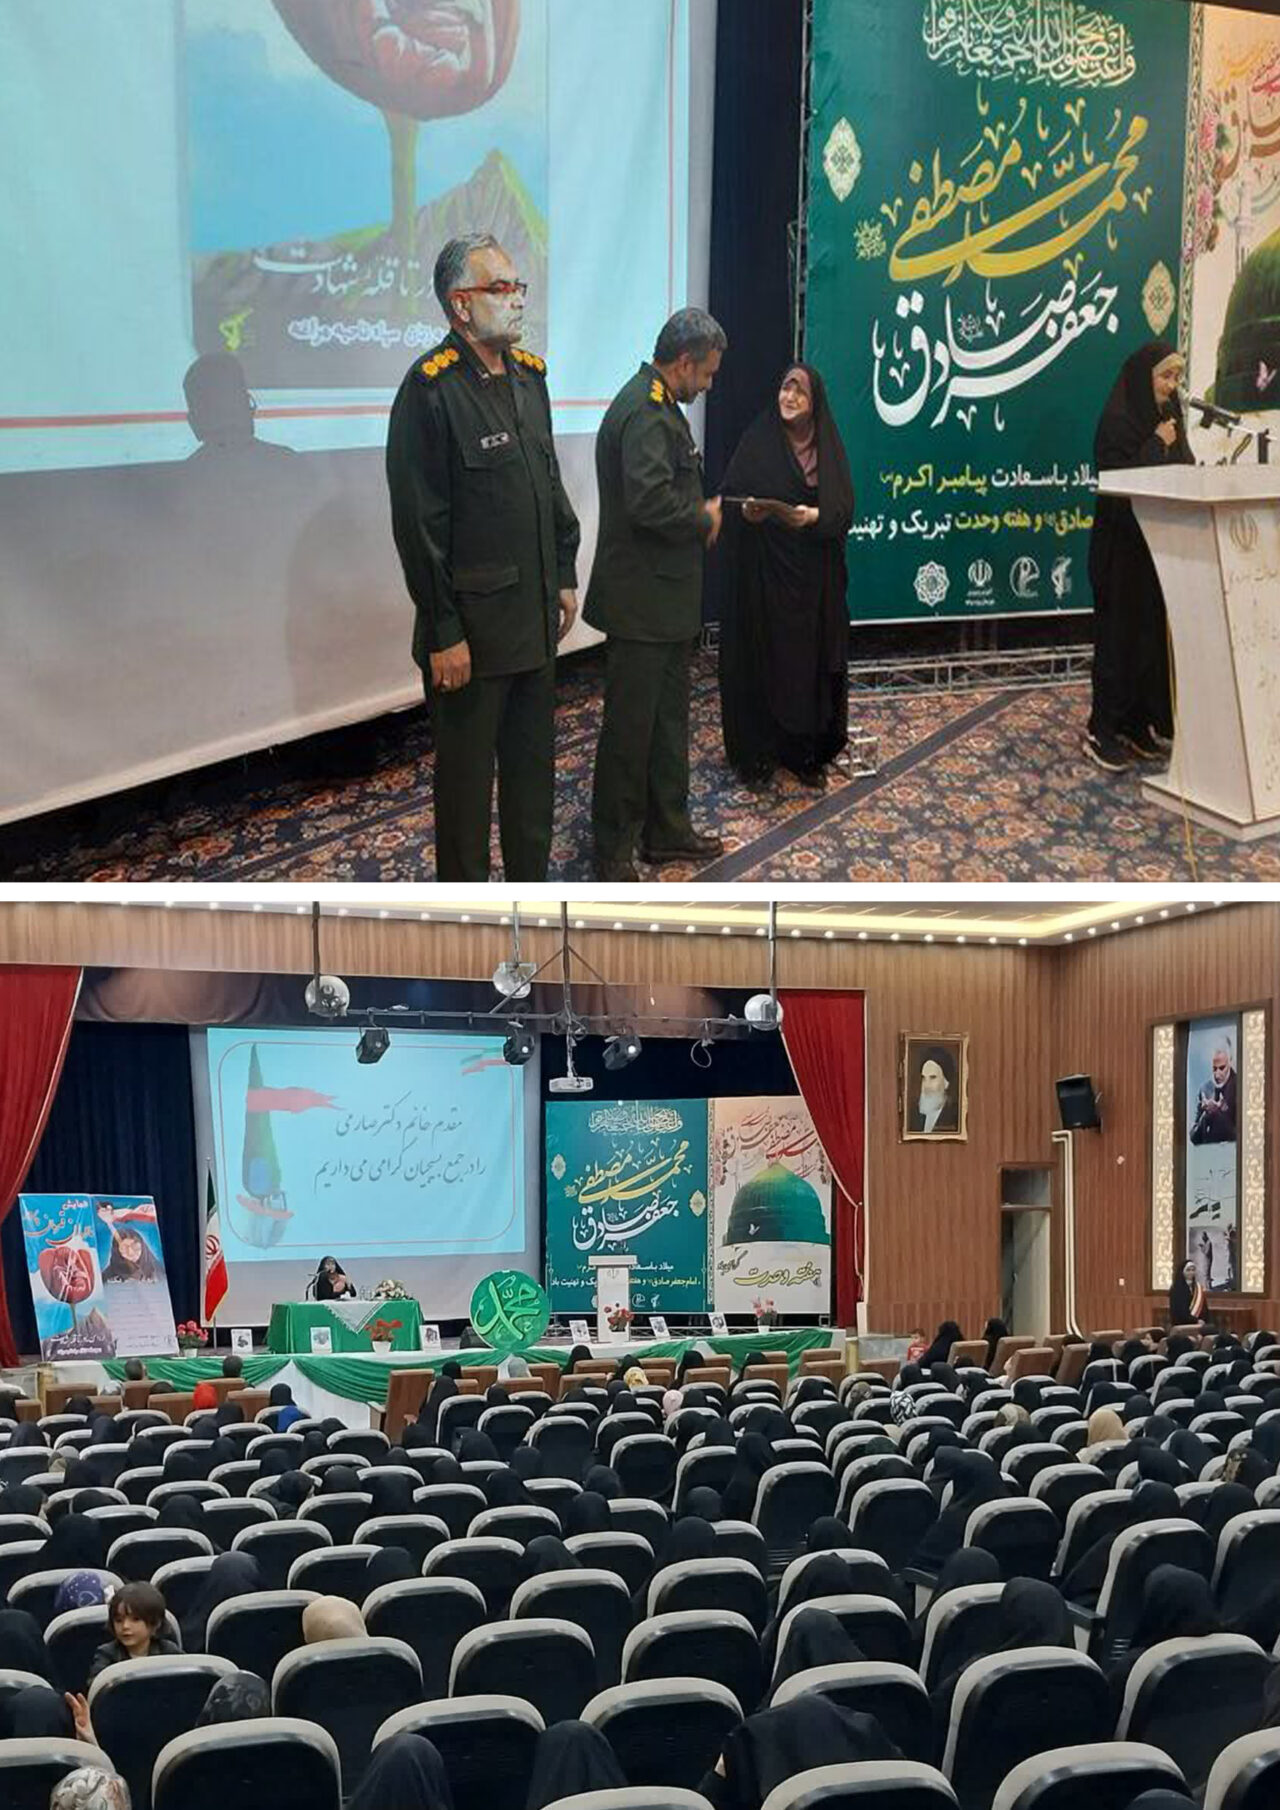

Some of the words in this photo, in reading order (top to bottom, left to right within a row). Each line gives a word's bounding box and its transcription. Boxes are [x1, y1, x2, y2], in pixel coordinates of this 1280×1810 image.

[253, 246, 359, 296] شهادت
[872, 279, 1076, 427] صادق
[936, 464, 987, 497] پیامبر
[991, 463, 1068, 492] باسعادت
[1071, 463, 1100, 492] یلاد
[848, 515, 884, 542] تهنی
[887, 517, 899, 541] و
[900, 508, 952, 540] تبریک
[955, 510, 1000, 535] وحدت
[1003, 506, 1032, 529] هفته
[1033, 513, 1042, 534] و
[372, 1090, 413, 1137] دکتر
[403, 1105, 431, 1149] خانم
[431, 1105, 463, 1149] مقدم
[442, 1152, 466, 1184] جمع
